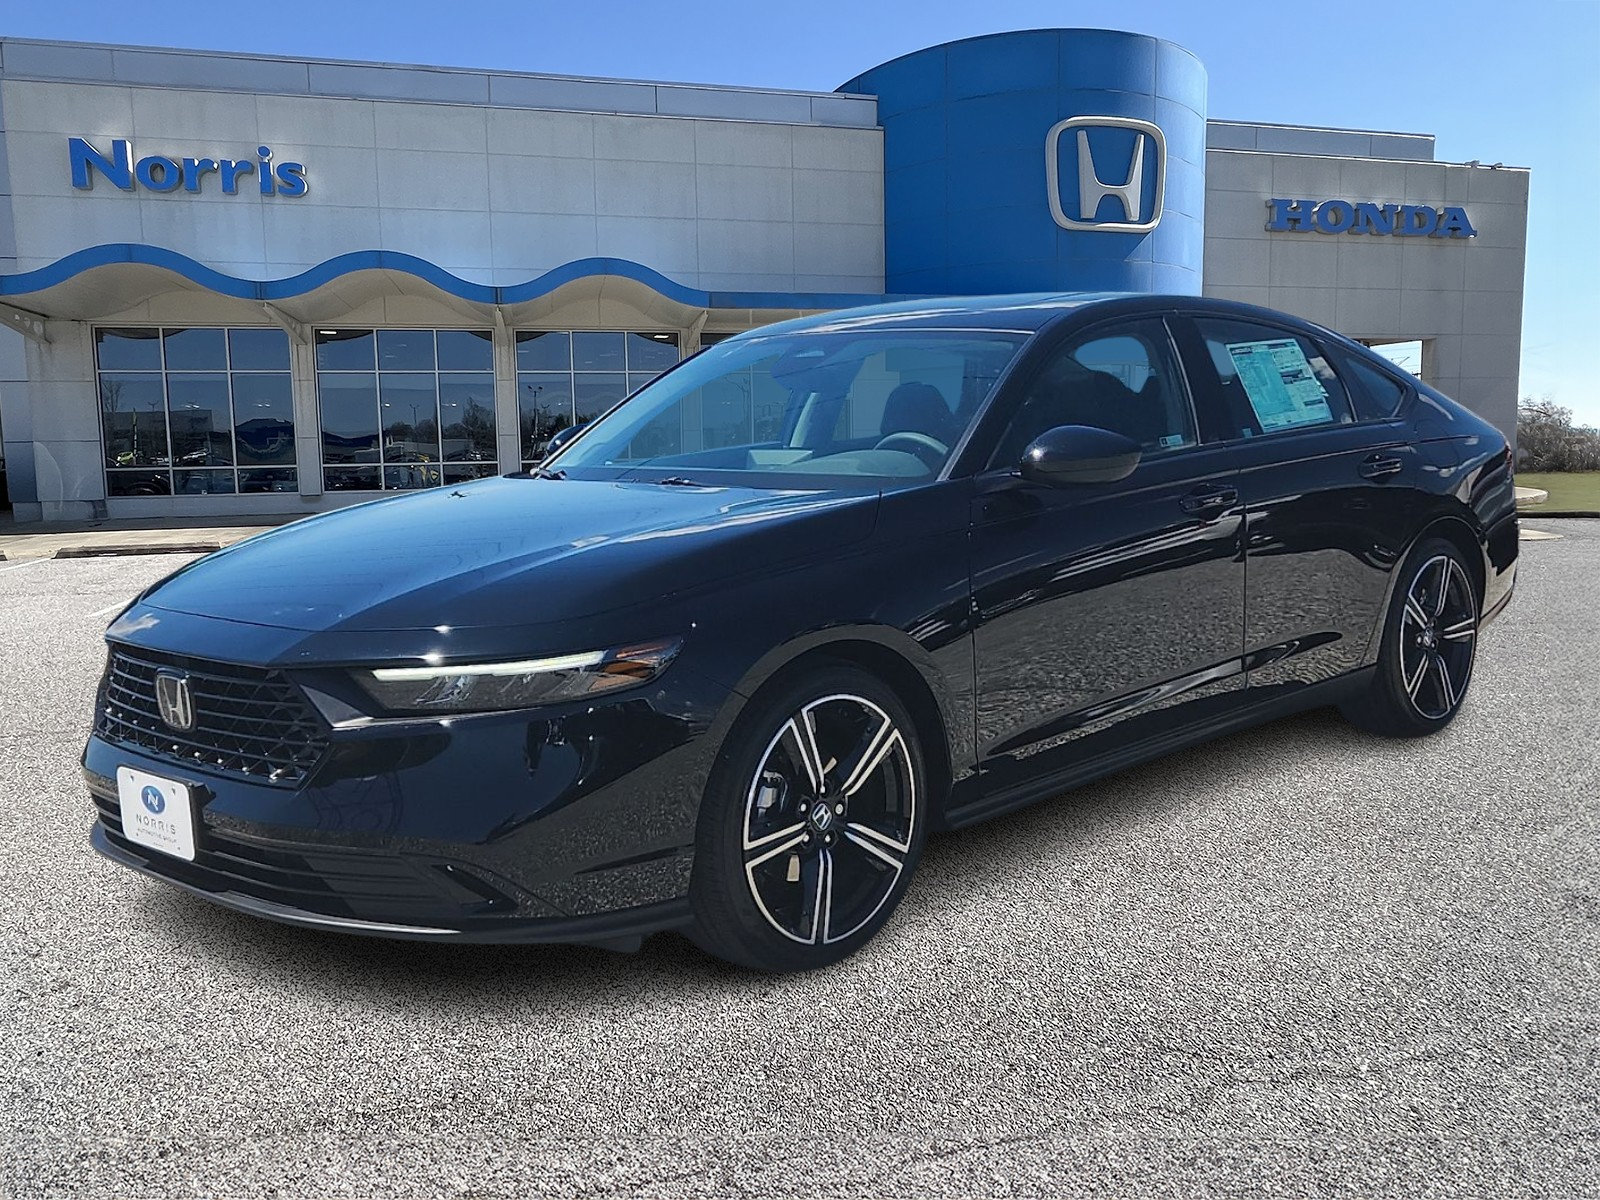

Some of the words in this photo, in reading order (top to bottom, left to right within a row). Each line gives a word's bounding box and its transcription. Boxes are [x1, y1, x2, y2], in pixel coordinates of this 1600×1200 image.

[68, 137, 309, 197] Norris
[1265, 198, 1478, 239] HONDA
[136, 814, 176, 835] NORRIS
